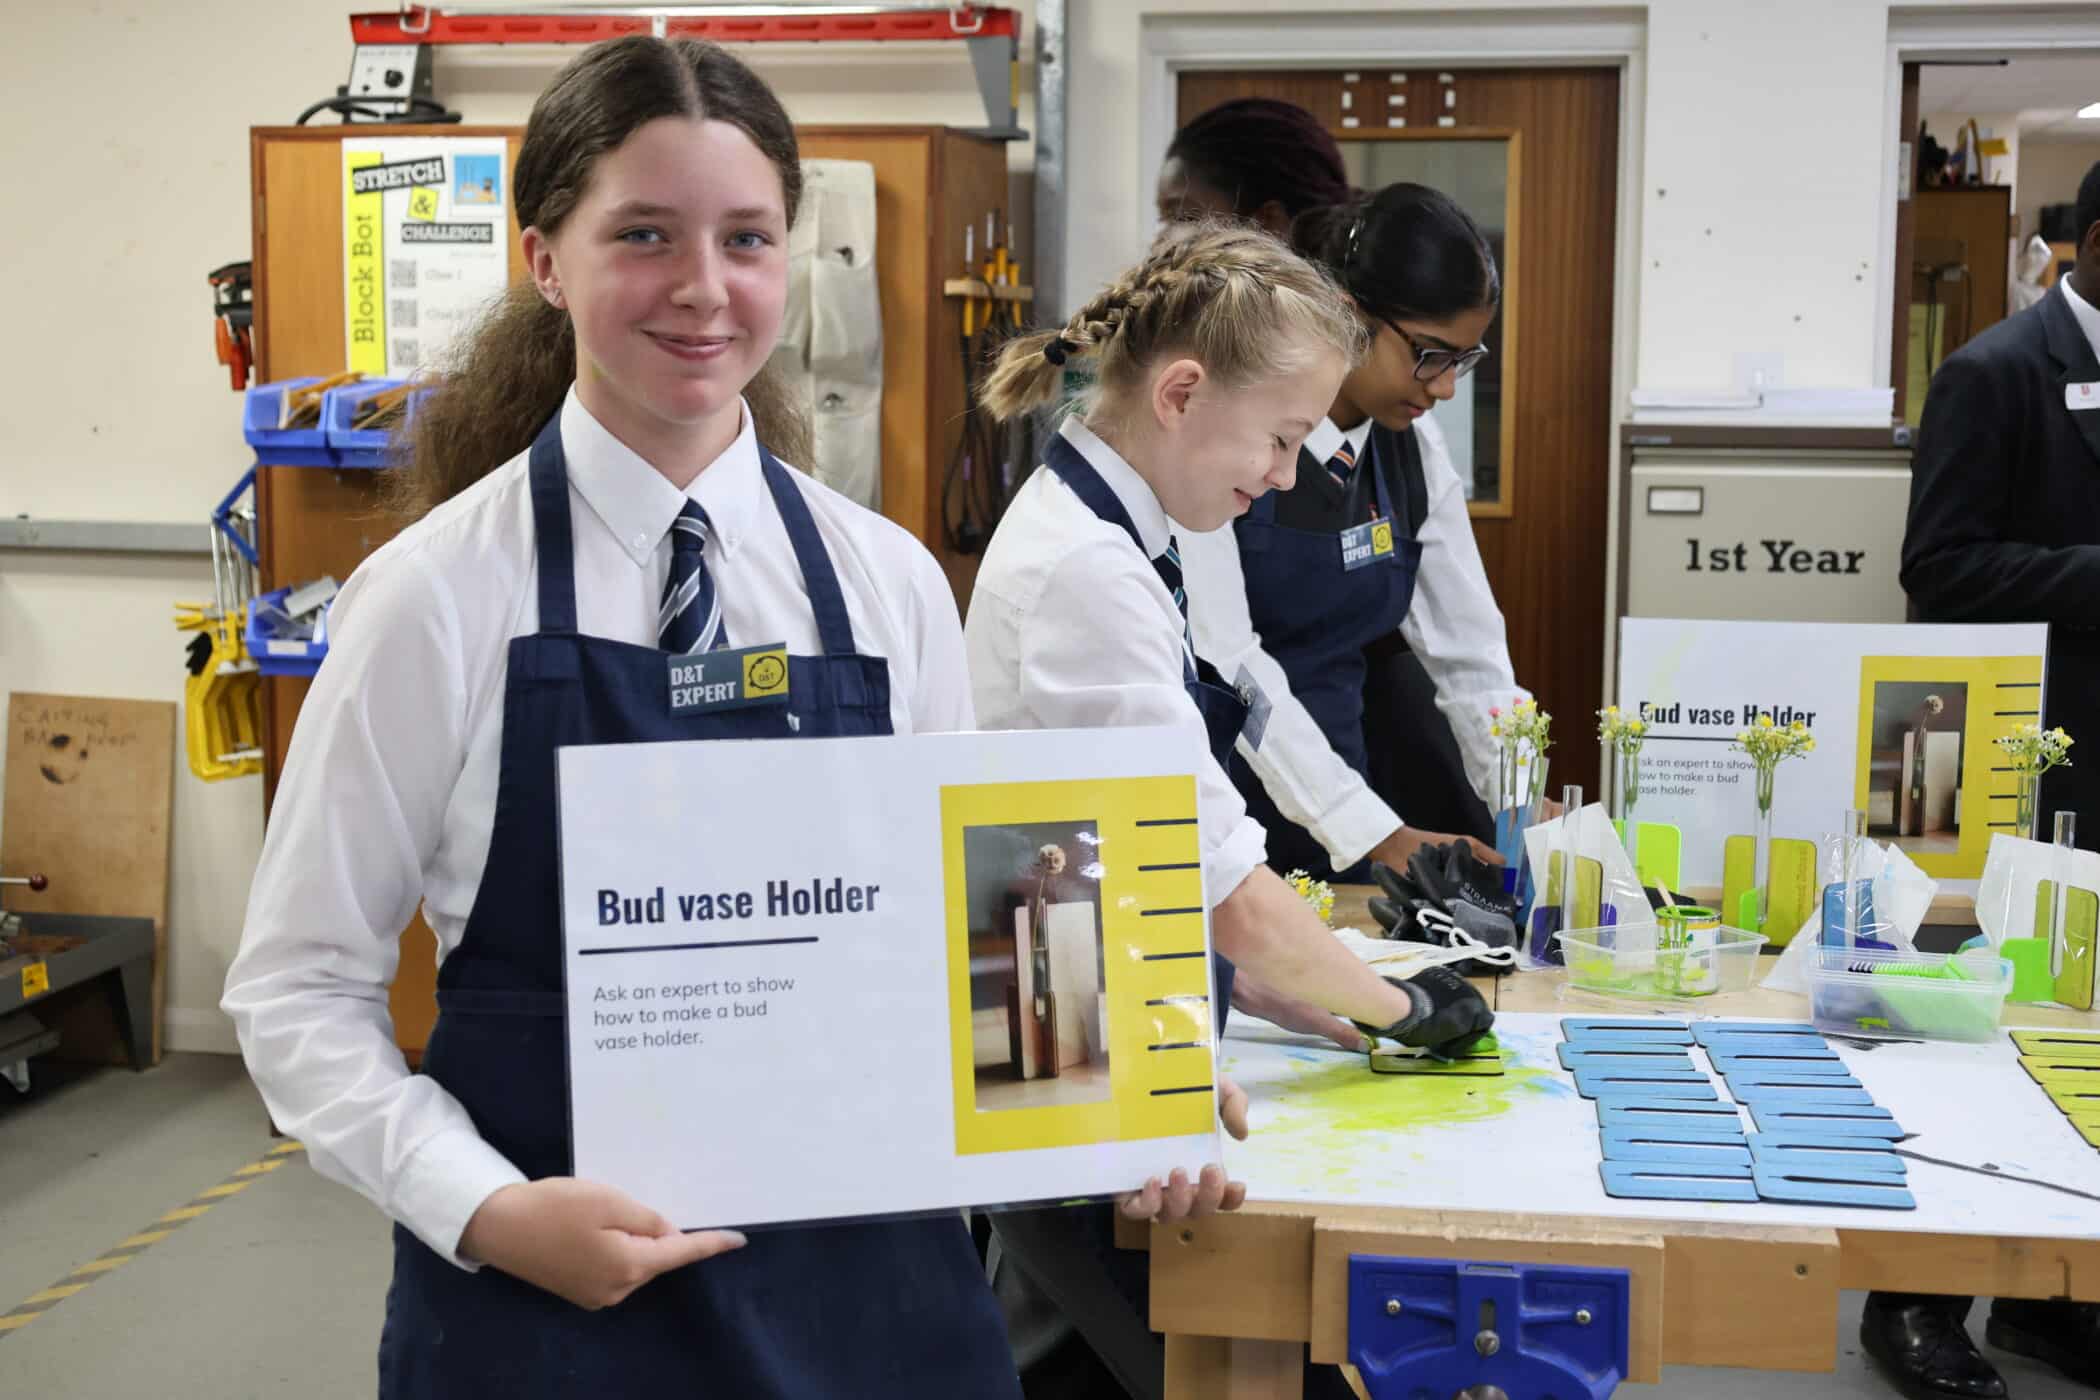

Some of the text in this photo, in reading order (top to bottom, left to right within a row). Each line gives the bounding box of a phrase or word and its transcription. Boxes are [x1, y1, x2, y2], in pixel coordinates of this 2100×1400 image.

[353, 159, 443, 191] STRETCH
[413, 195, 432, 216] &
[401, 225, 491, 241] CHALLENGE
[351, 214, 375, 343] Block Bot
[1685, 537, 1866, 575] 1st Year
[671, 664, 705, 686] D&T
[671, 681, 737, 708] EXPERT
[1688, 708, 1735, 726] vase
[1656, 759, 1671, 768] an
[1673, 757, 1710, 774] expert
[1712, 760, 1724, 769] to
[1659, 772, 1673, 781] to
[1674, 772, 1704, 784] make
[1717, 773, 1740, 784] bud
[597, 876, 881, 927] Bud vase Holder
[593, 976, 796, 1003] Ask an expert to show
[593, 1000, 769, 1027] how to make a bud
[594, 1030, 706, 1051] vase holder.
